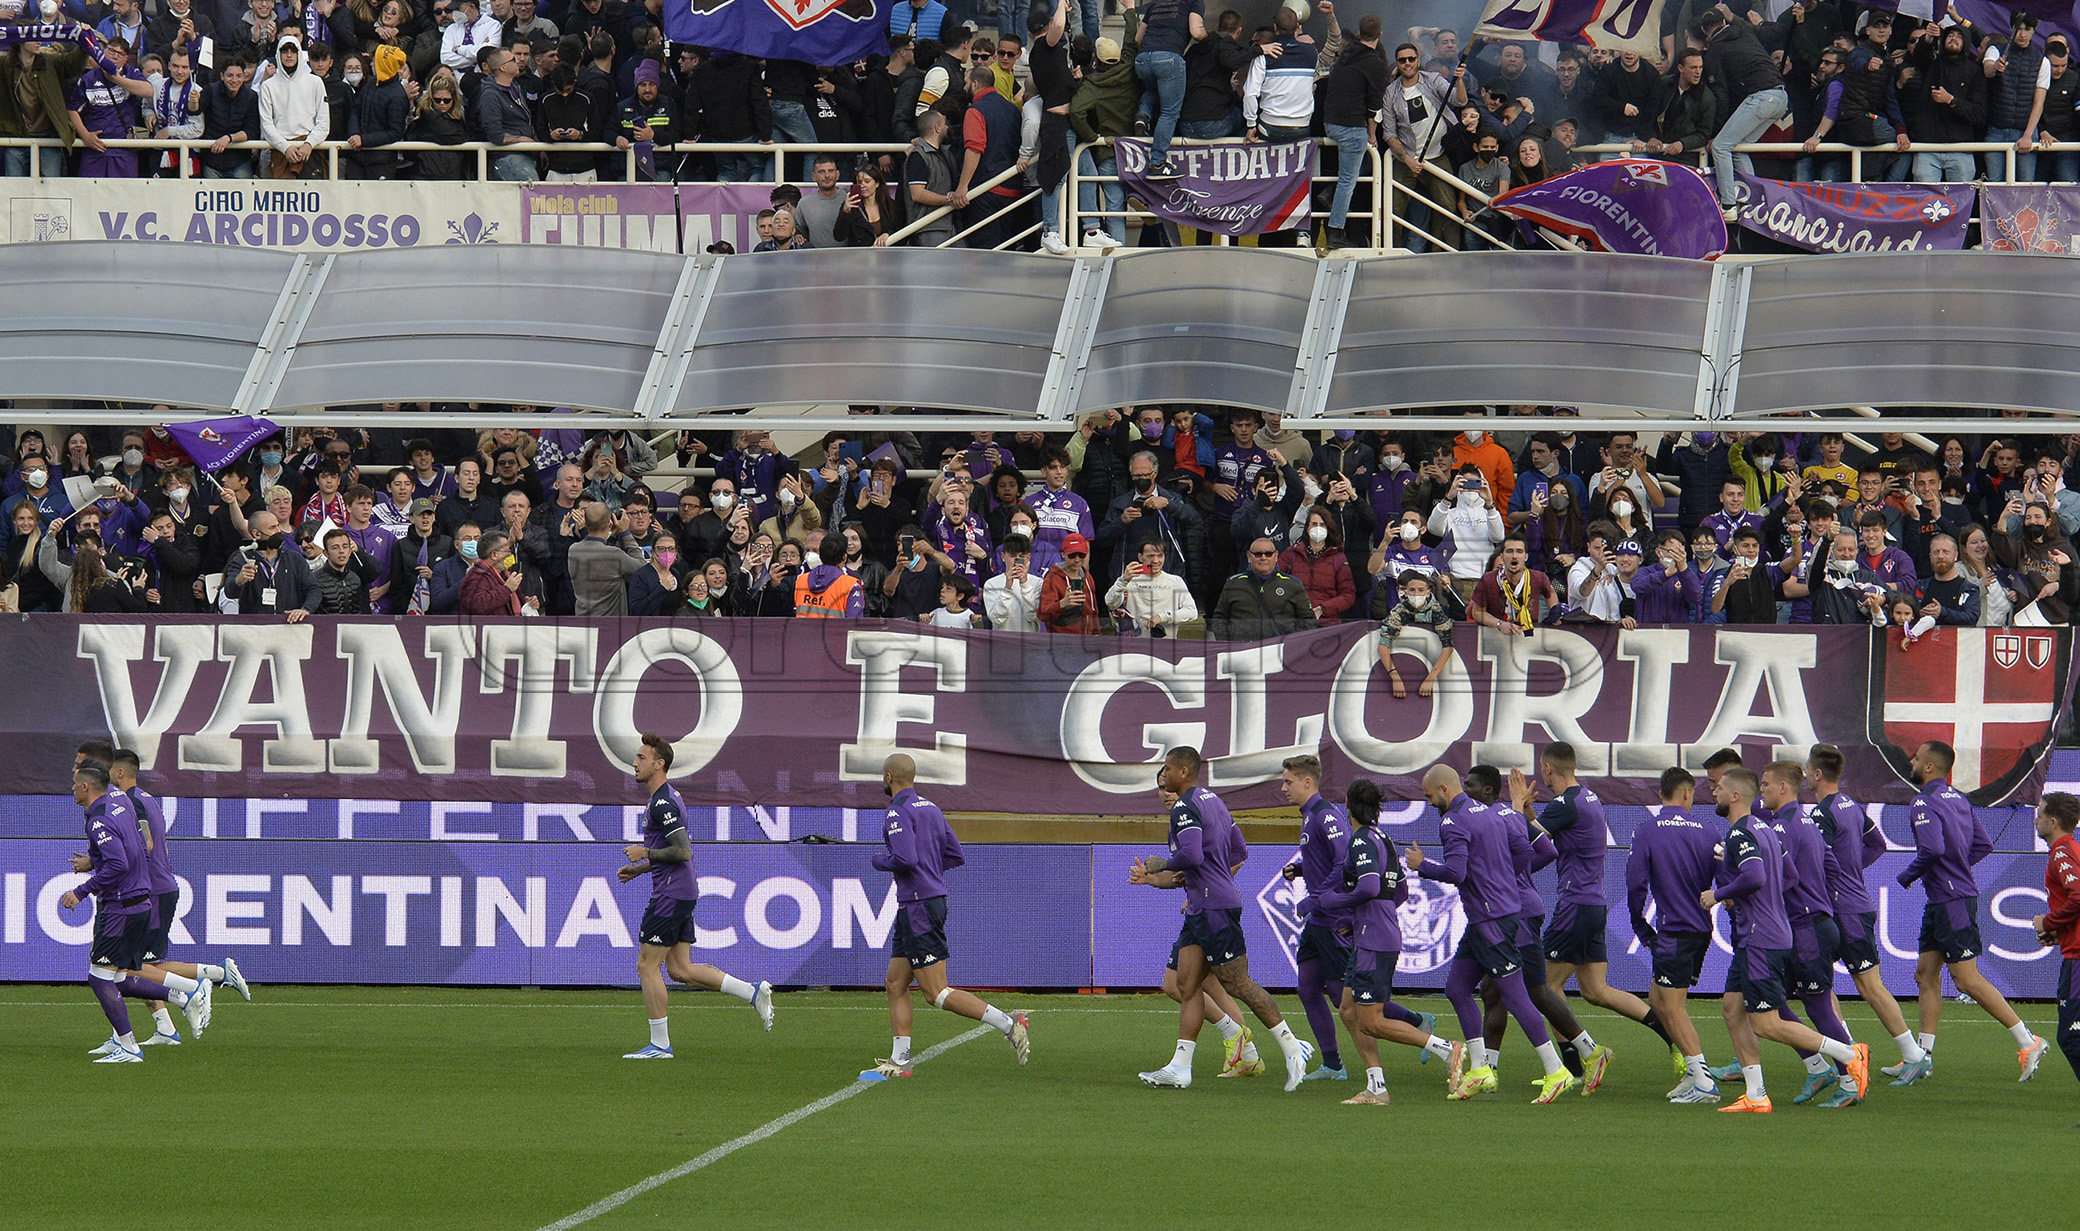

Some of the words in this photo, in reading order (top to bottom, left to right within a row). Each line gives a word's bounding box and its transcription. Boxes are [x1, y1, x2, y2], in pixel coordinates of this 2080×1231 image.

[17, 24, 82, 41] VIOLA
[93, 91, 127, 103] Medacom
[1119, 139, 1312, 182] DFFIDATI
[195, 190, 244, 213] CIAO
[253, 191, 321, 213] MARIO
[530, 194, 574, 215] viola
[577, 194, 618, 215] club
[1162, 187, 1264, 233] Firenze
[98, 211, 170, 241] V.C.
[184, 212, 421, 248] ARCIDOSSO
[220, 426, 269, 465] FIORENTINA
[803, 594, 826, 607] Ref.
[76, 622, 744, 779] VANTO
[839, 630, 967, 787] E
[1060, 628, 1819, 795] GLORIA
[1656, 819, 1703, 829] FIORENTINA
